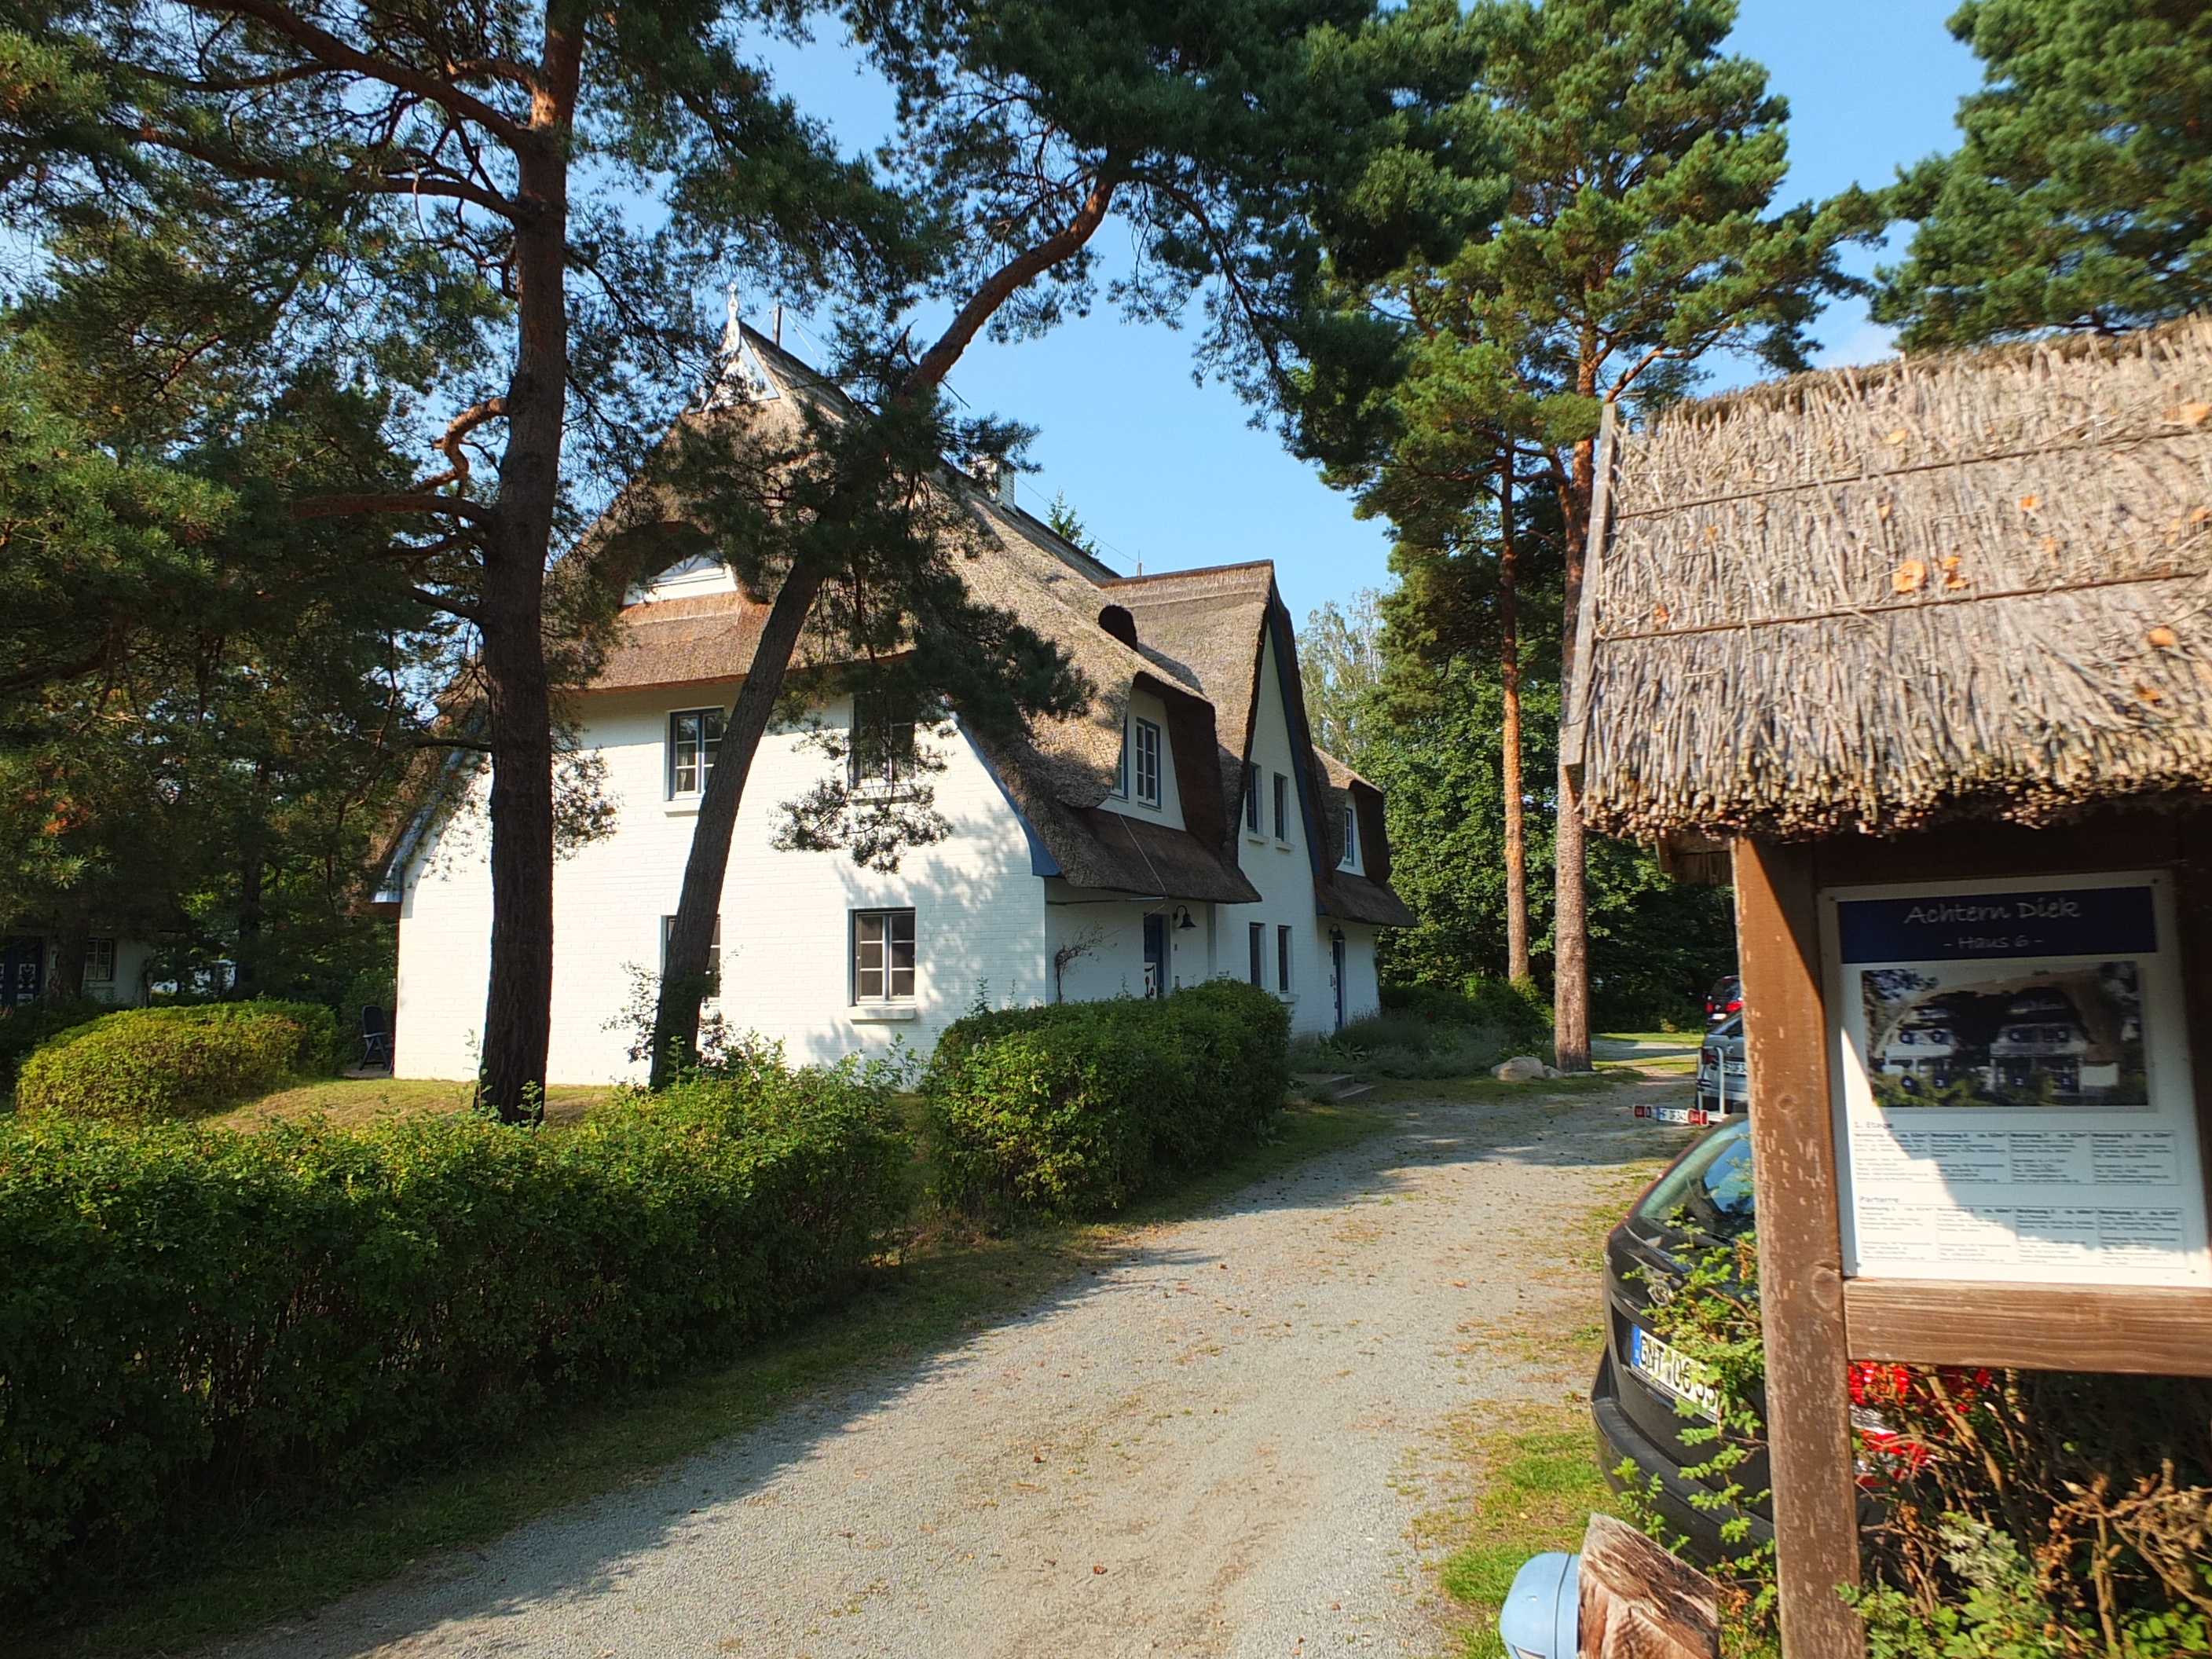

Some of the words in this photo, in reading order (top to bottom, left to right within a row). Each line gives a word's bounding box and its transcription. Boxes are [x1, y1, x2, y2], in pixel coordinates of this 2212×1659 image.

[1903, 903, 2011, 924] Achtern
[2016, 898, 2081, 917] Diek
[1958, 936, 2009, 950] Haus
[2015, 935, 2030, 947] 6
